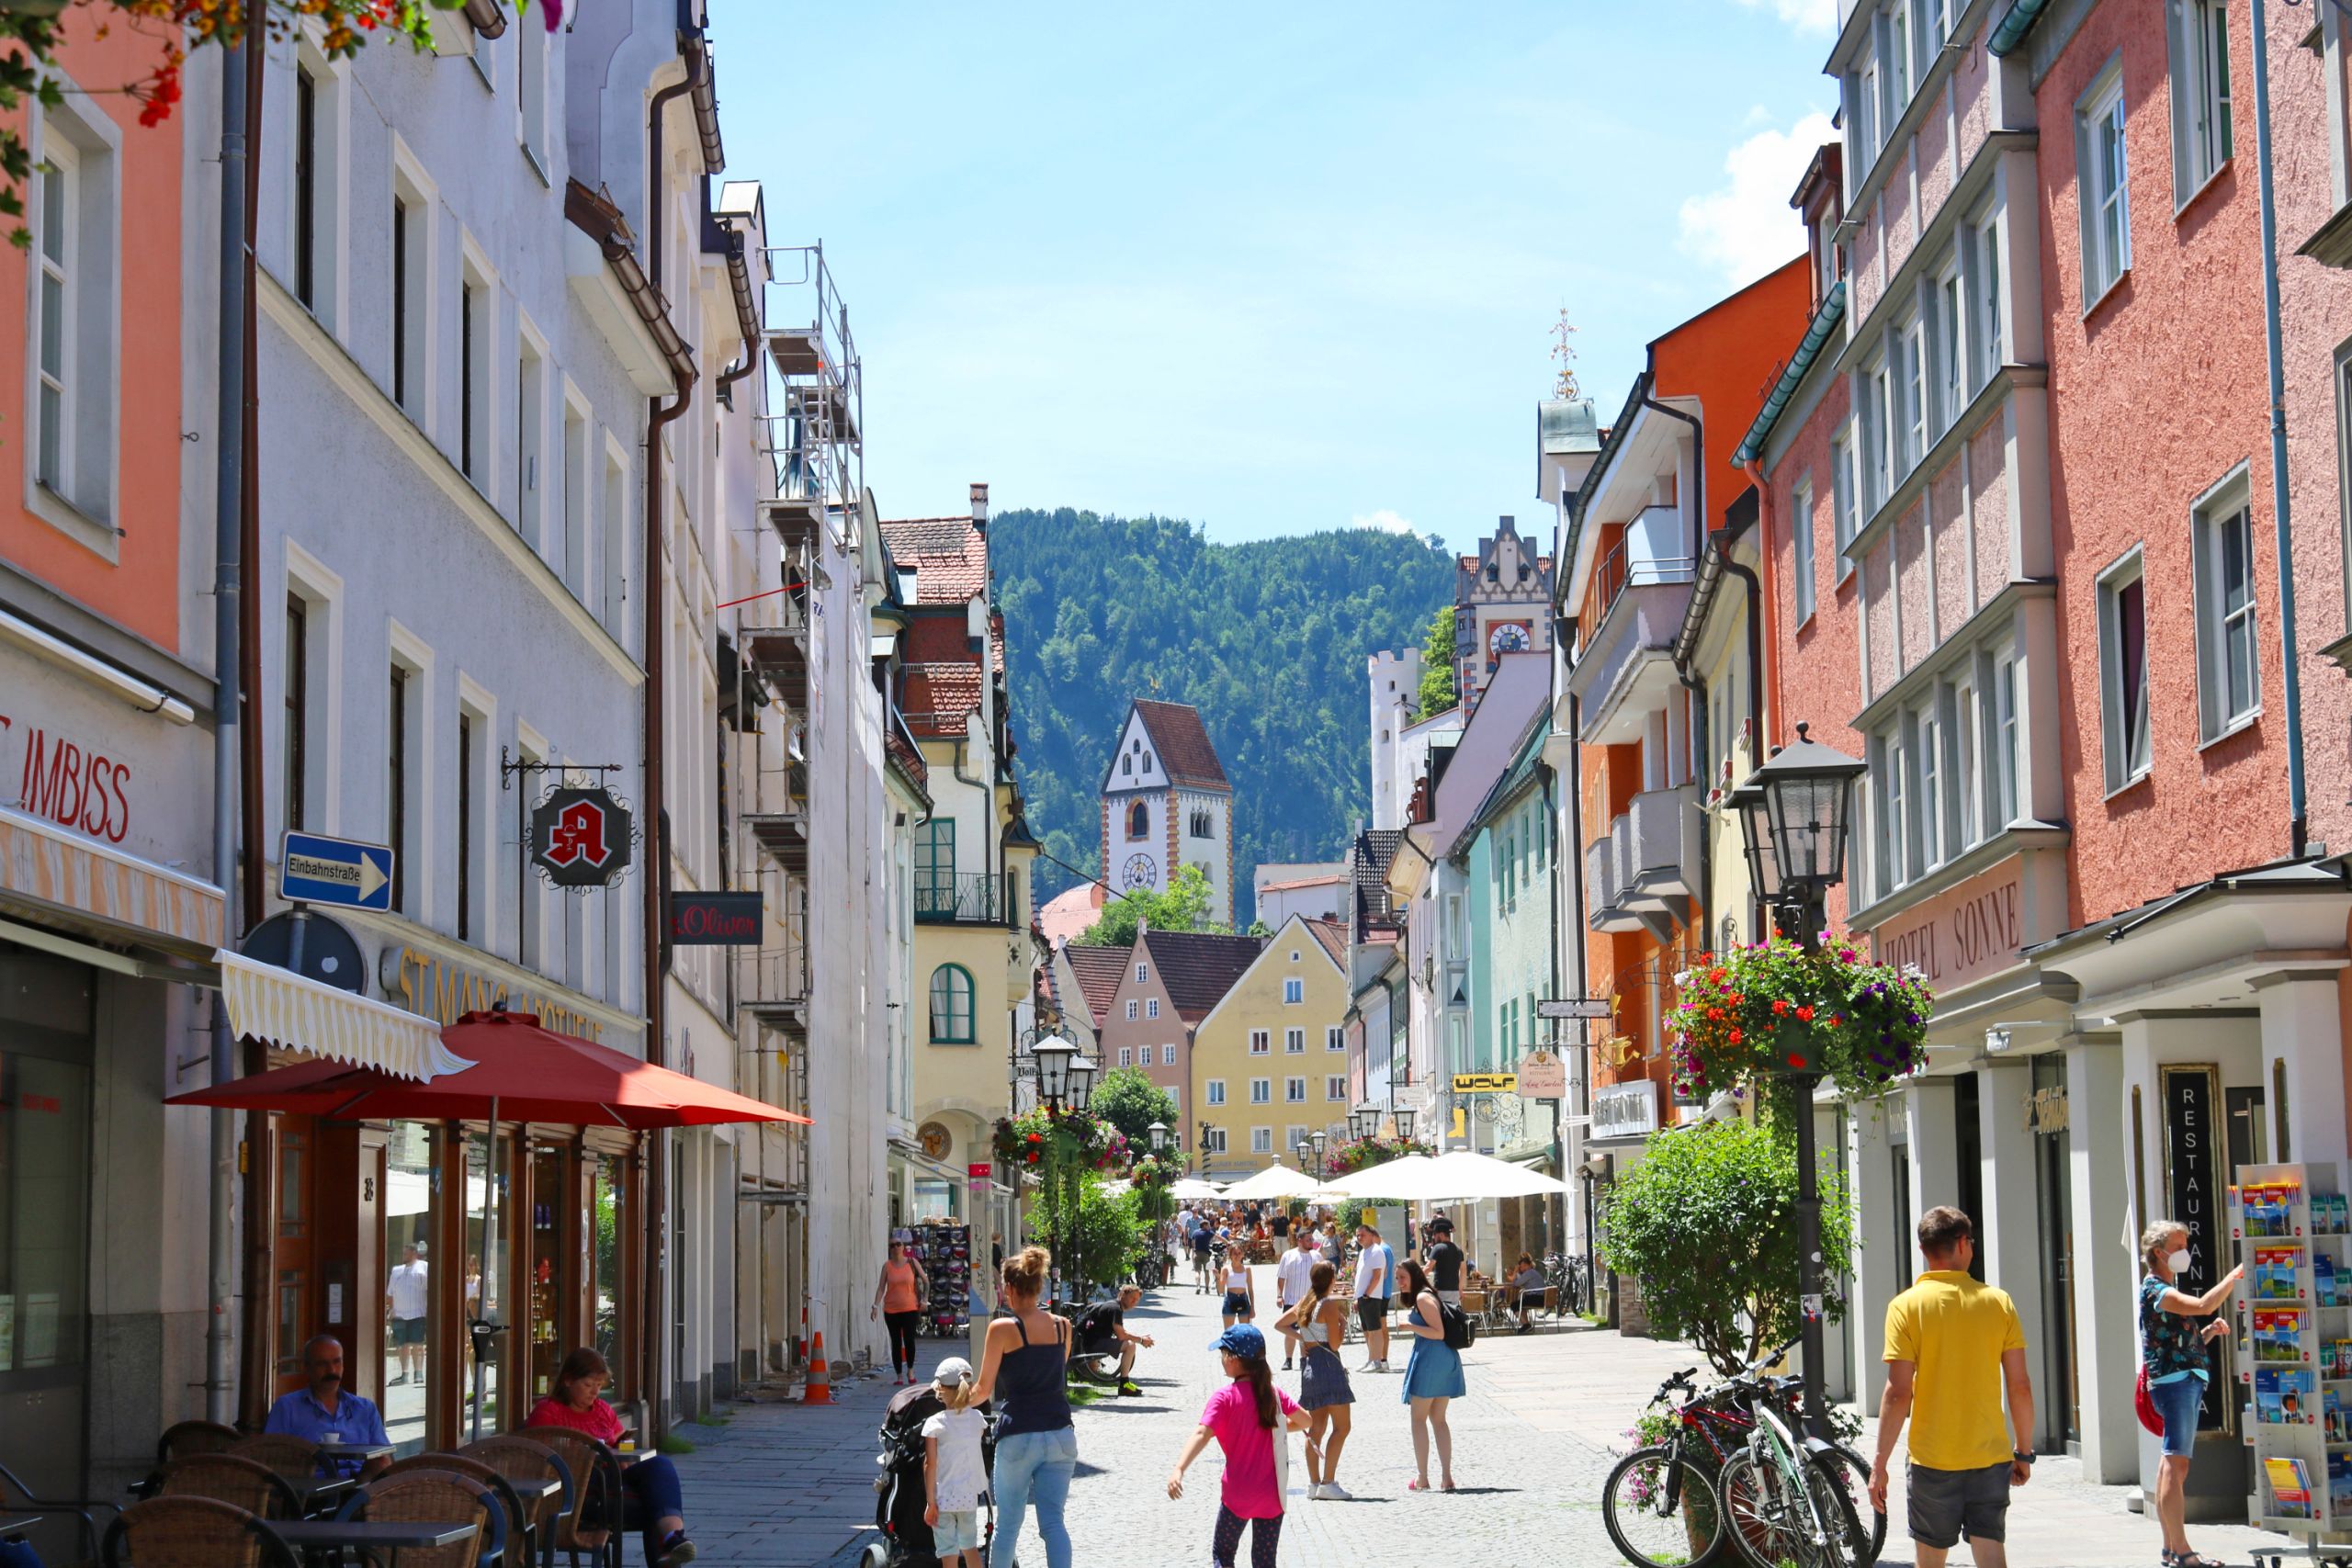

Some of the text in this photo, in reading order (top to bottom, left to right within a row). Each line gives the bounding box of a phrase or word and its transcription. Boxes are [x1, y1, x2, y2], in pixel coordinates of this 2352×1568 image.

[21, 727, 130, 843] IMBISS
[288, 857, 360, 882] Einbahnstraße
[1954, 881, 2019, 971] SONNE
[1455, 1077, 1515, 1089] WOLF
[2183, 1088, 2204, 1299] RESTAURANT
